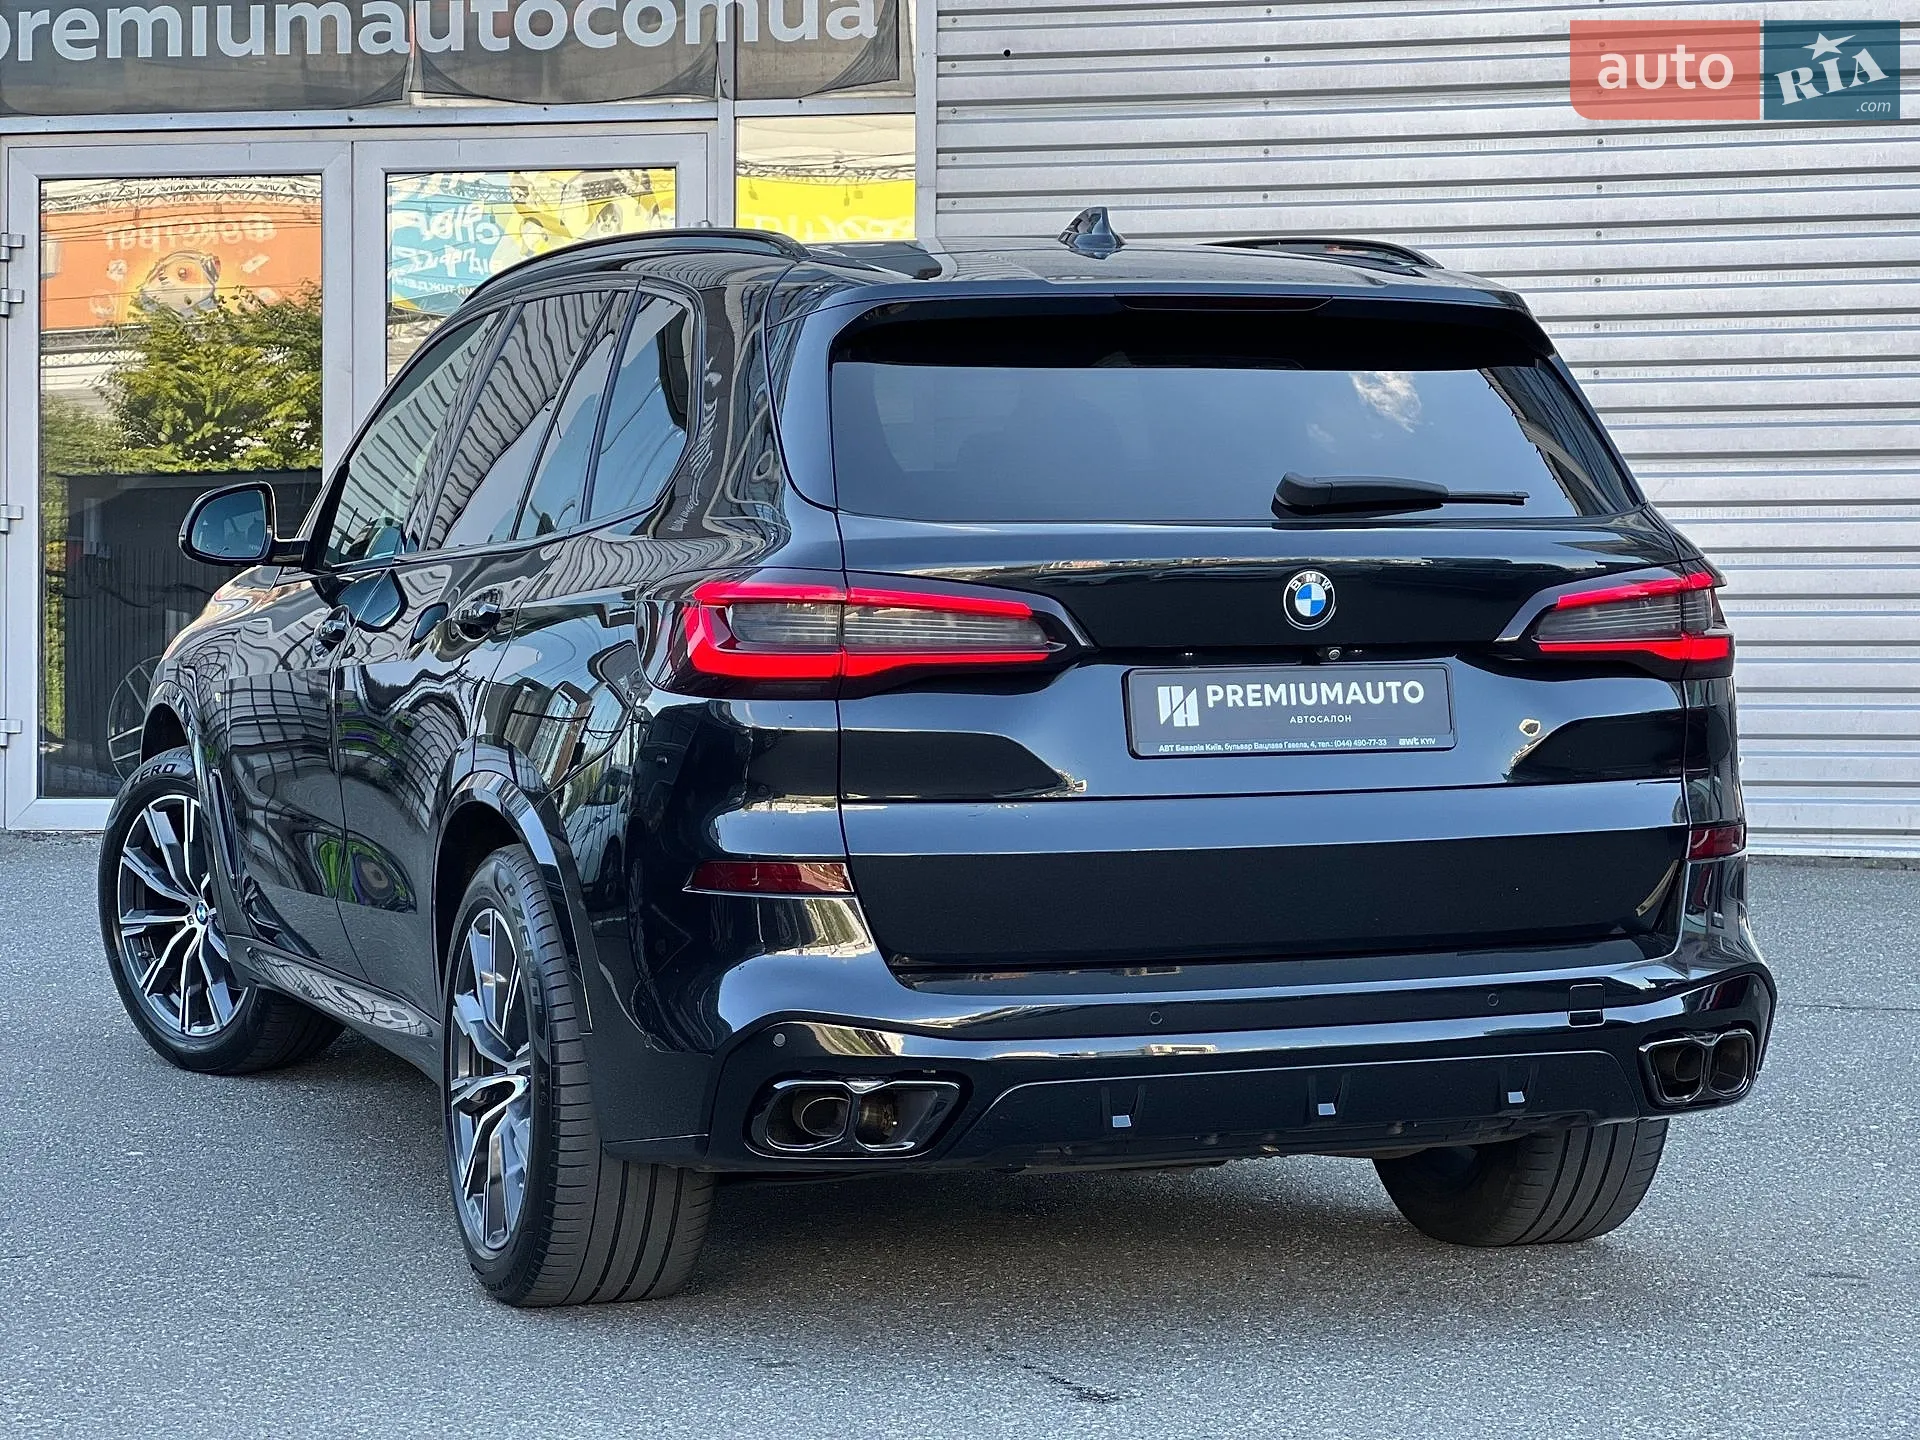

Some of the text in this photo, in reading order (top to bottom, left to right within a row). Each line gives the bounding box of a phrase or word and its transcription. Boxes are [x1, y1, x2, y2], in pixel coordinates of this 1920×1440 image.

[0, 0, 878, 62] remiumautocomua
[1290, 573, 1332, 591] BMW
[1206, 680, 1425, 708] PREMIUMAUTO
[1289, 714, 1352, 724] АВТОСАЛОН
[1334, 739, 1352, 748] (044)
